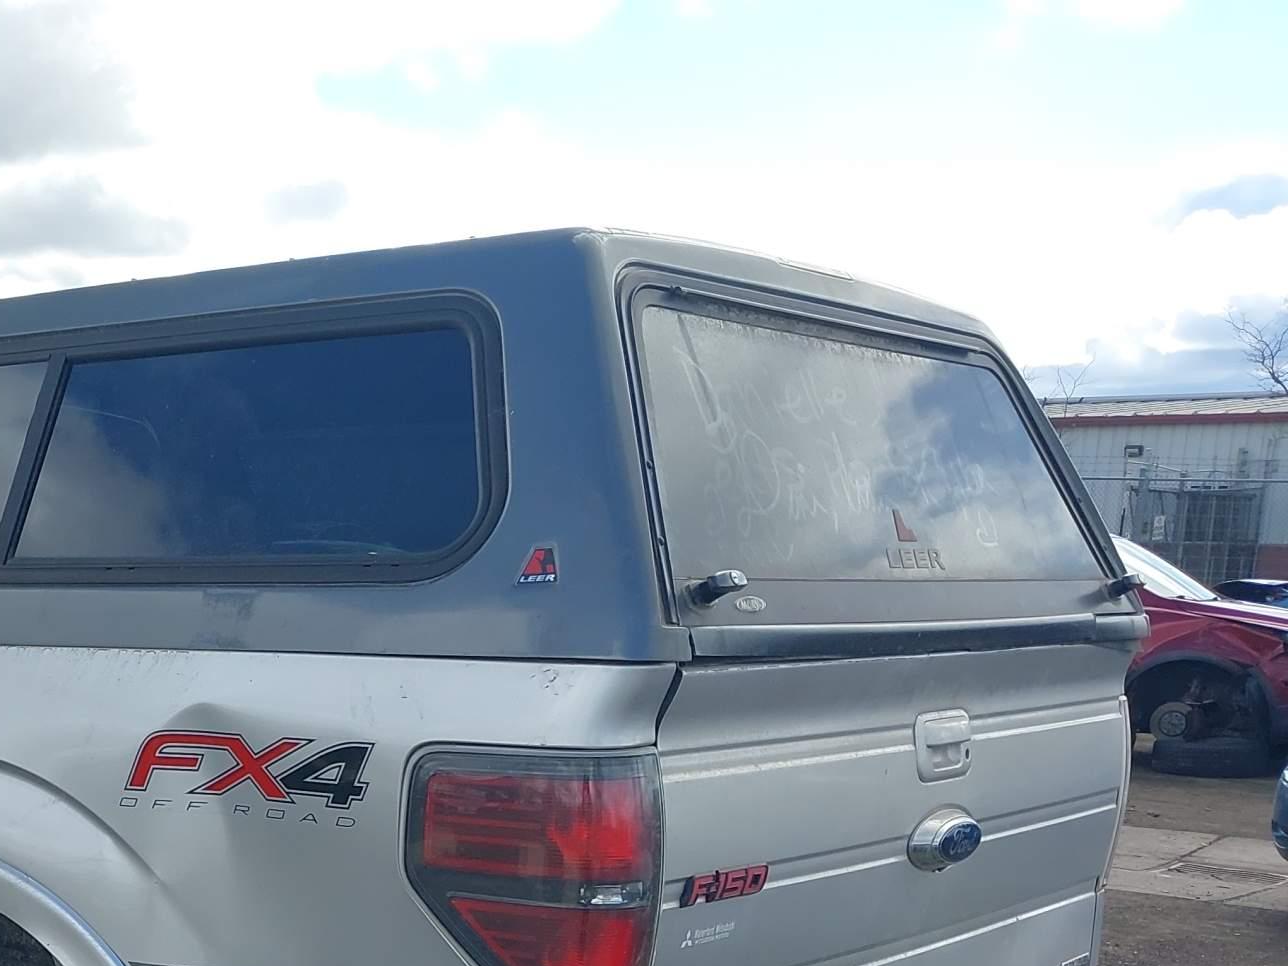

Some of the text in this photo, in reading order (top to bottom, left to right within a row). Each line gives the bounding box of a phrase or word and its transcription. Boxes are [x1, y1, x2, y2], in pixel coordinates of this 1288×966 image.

[885, 547, 946, 571] LEER
[519, 573, 556, 584] LEER
[123, 728, 377, 811] FX4
[118, 796, 356, 829] OFF ROAD
